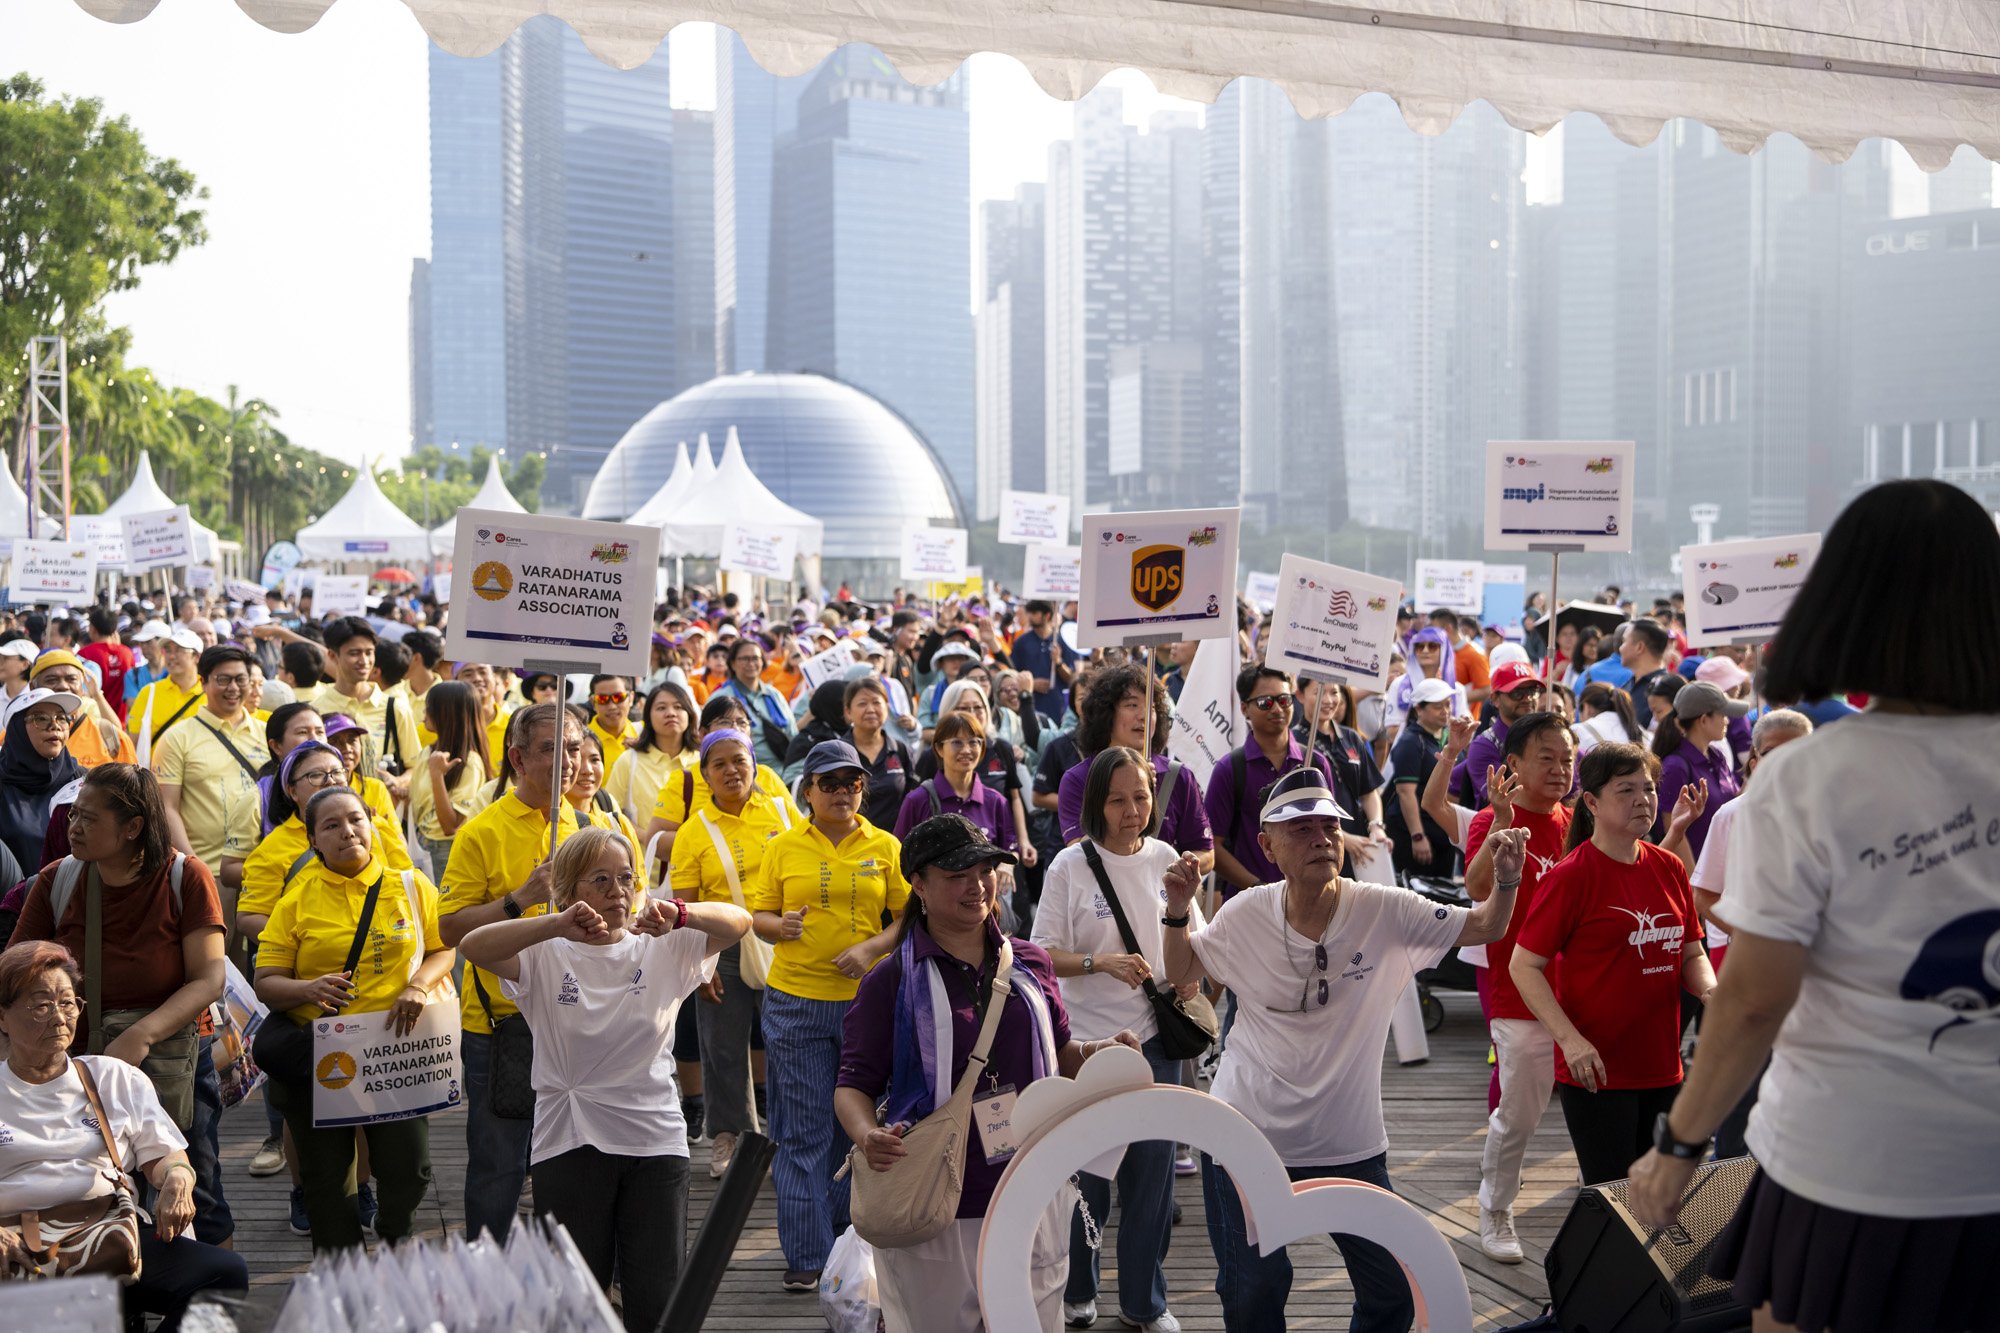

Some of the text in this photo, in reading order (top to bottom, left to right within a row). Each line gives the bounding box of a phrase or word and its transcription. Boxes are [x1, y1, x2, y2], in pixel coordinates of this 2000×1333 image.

[521, 564, 622, 585] VARADHATUS
[1135, 564, 1180, 602] ups
[518, 582, 622, 602] RATANARAMA
[517, 600, 620, 619] ASSOCIATION
[1323, 617, 1358, 631] AmChamSG
[1321, 640, 1346, 653] PayPal
[1175, 713, 1192, 733] cacy
[1859, 803, 1976, 870] To Serve with
[1908, 850, 1948, 877] Love
[1642, 965, 1674, 975] SINGAPORE
[363, 1034, 452, 1059] VARADHATUS
[362, 1050, 453, 1077] RATANARAMA
[363, 1067, 452, 1093] ASSOCIATION
